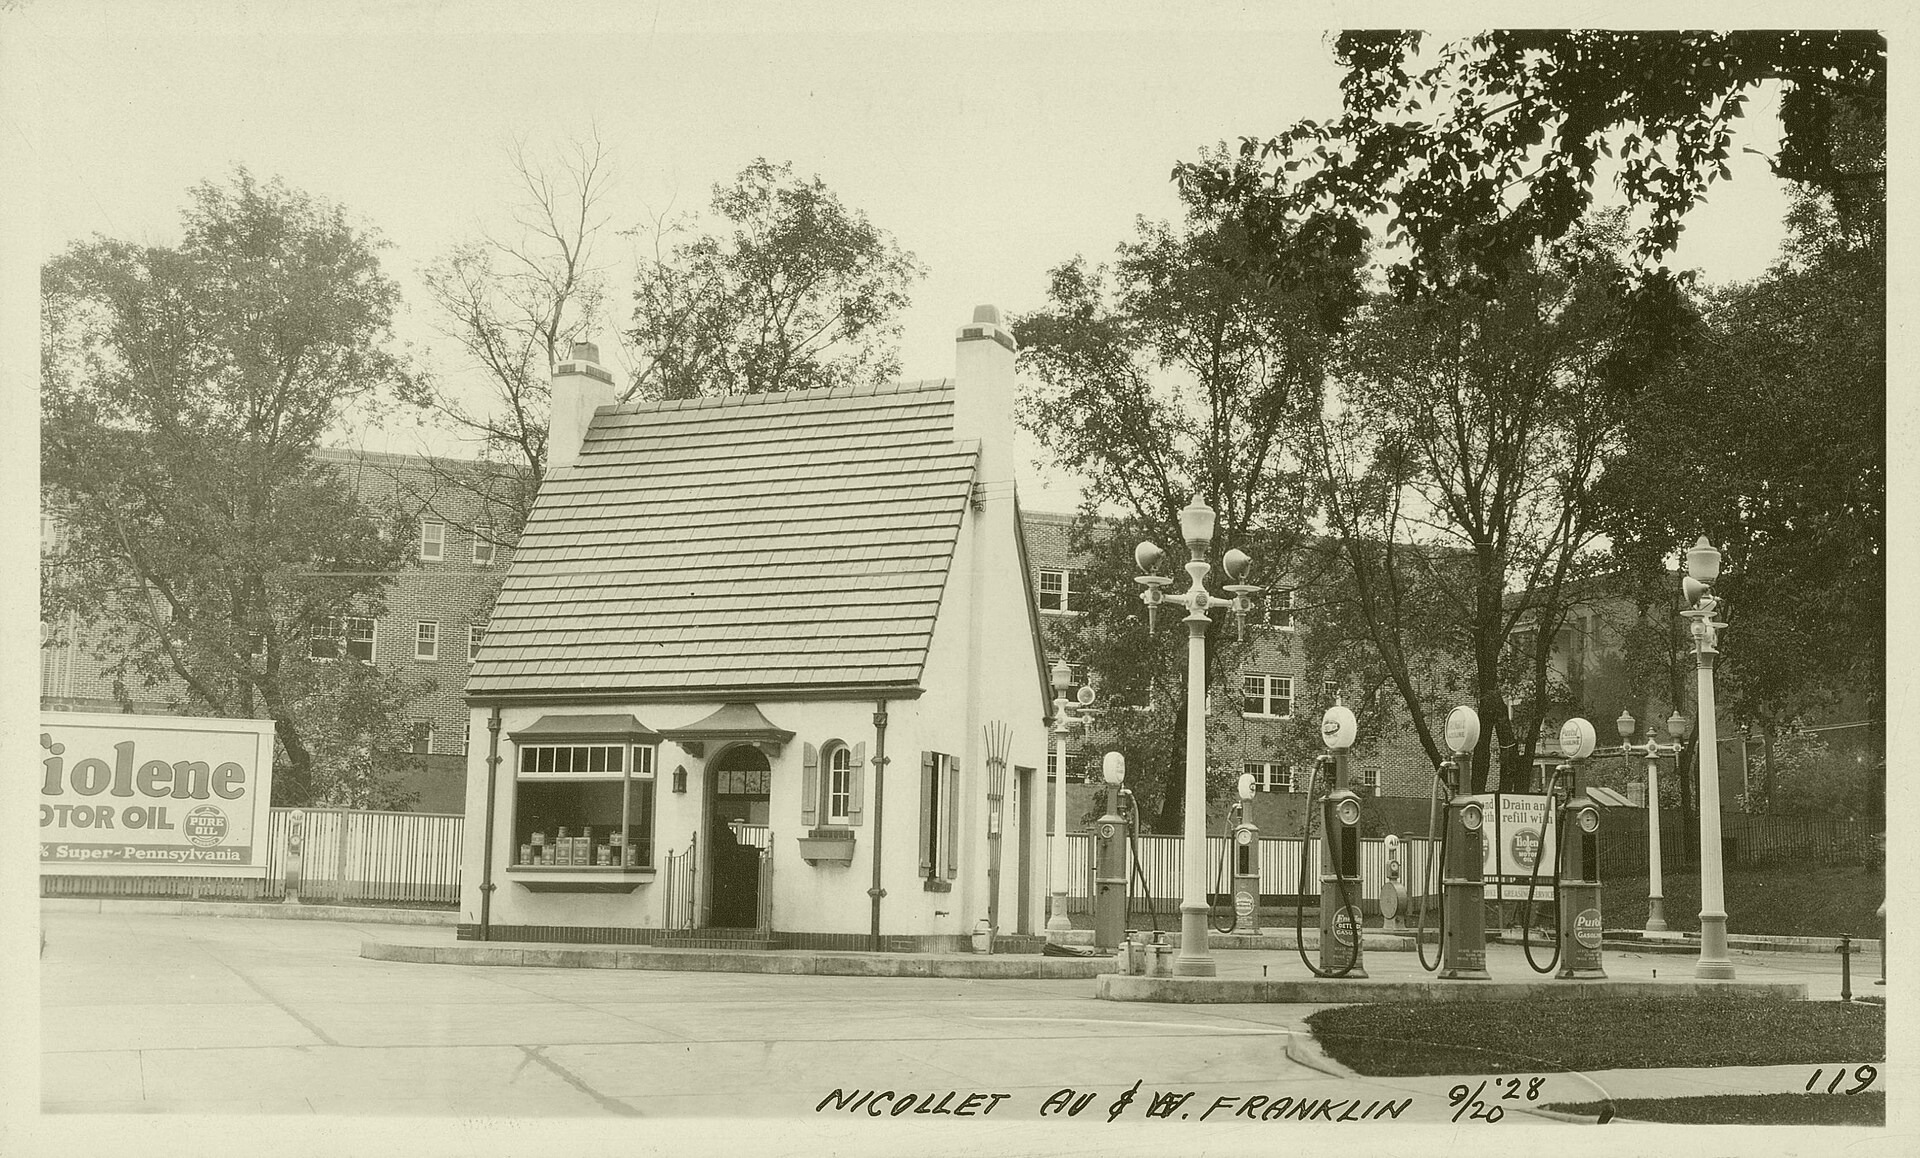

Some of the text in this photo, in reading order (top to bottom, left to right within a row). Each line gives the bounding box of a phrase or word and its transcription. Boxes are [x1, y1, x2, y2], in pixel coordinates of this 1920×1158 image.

[40, 733, 246, 800] iolene
[1502, 798, 1552, 812] Drain an
[121, 805, 175, 830] OIL
[189, 816, 224, 827] PURE
[1502, 811, 1553, 824] refill wih
[195, 826, 218, 835] OIL
[1515, 835, 1539, 847] Tiolen
